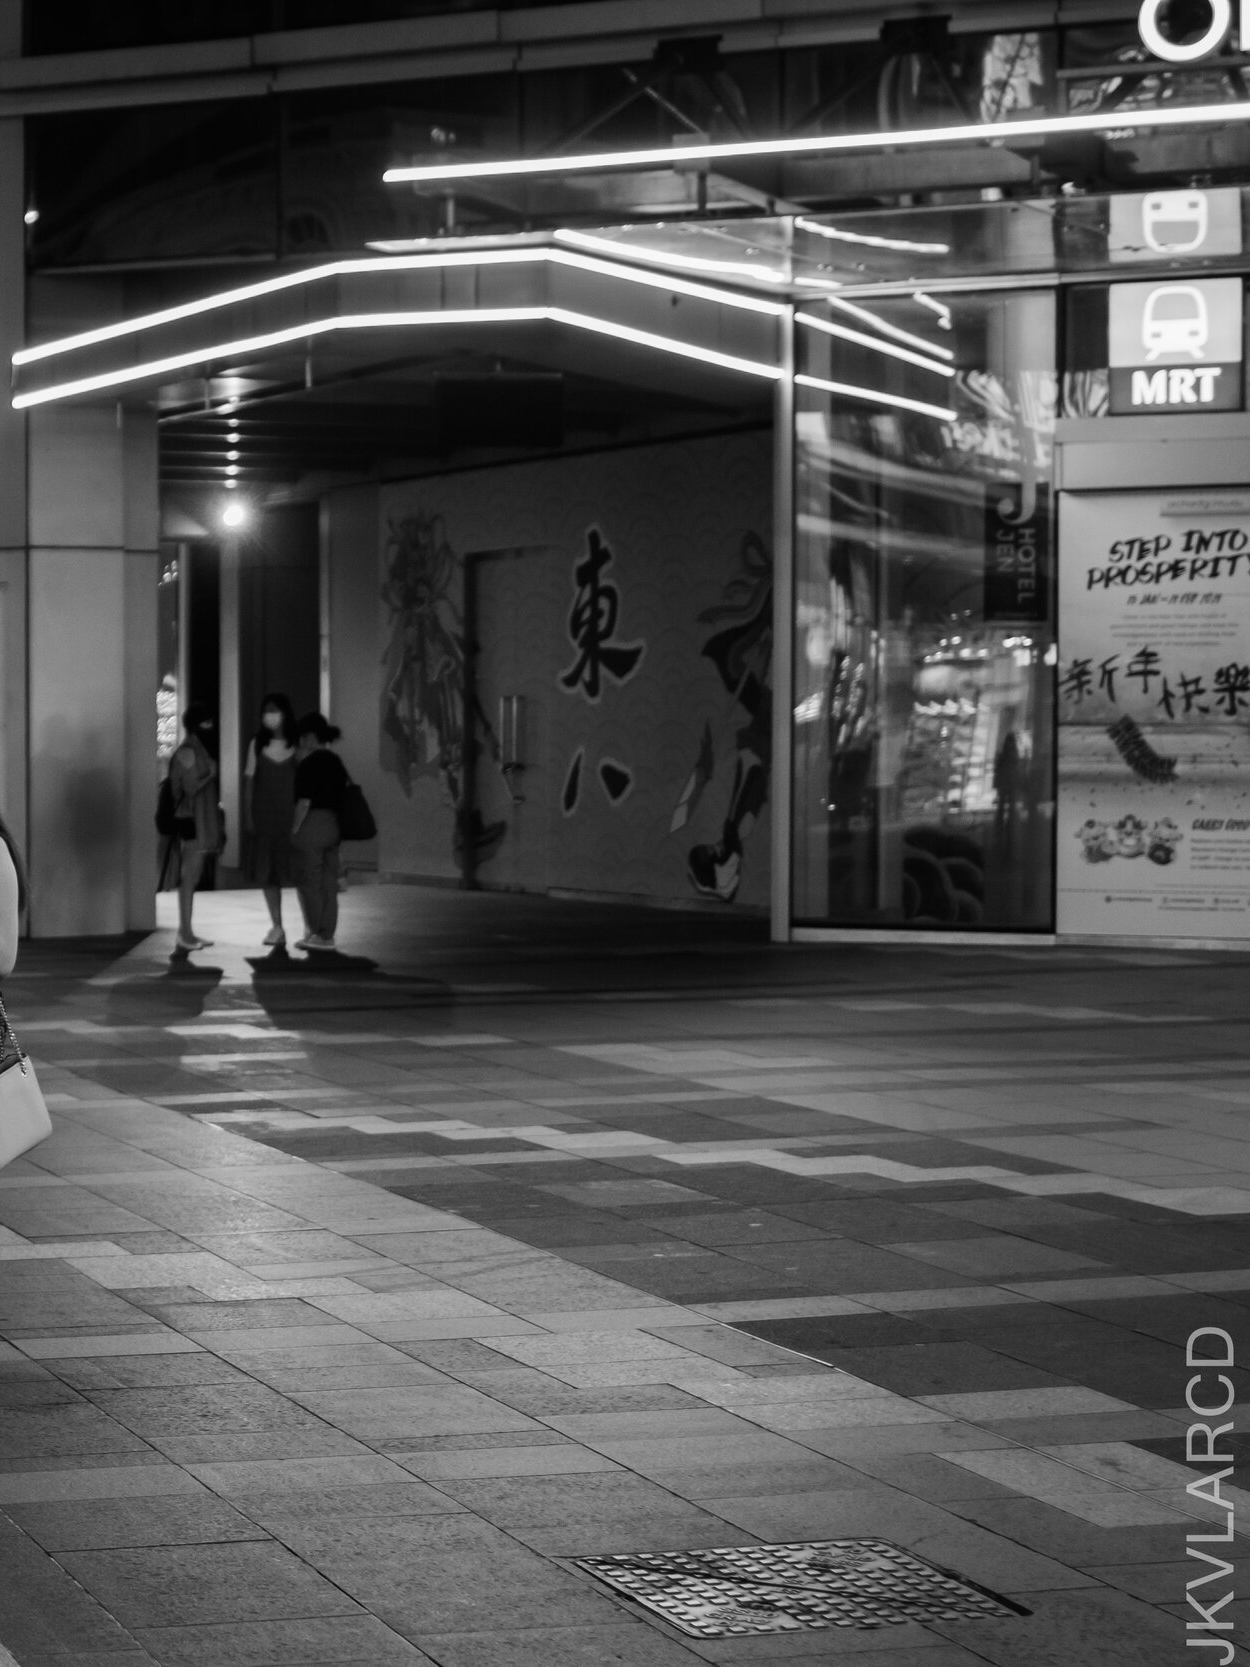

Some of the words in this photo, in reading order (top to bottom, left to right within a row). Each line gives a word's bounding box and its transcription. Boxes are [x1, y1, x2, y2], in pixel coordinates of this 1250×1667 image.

[1131, 366, 1222, 405] MRT
[996, 528, 1015, 572] JEN
[1017, 527, 1036, 604] HOTEL
[1108, 535, 1172, 564] STEP
[1181, 528, 1249, 555] INTO
